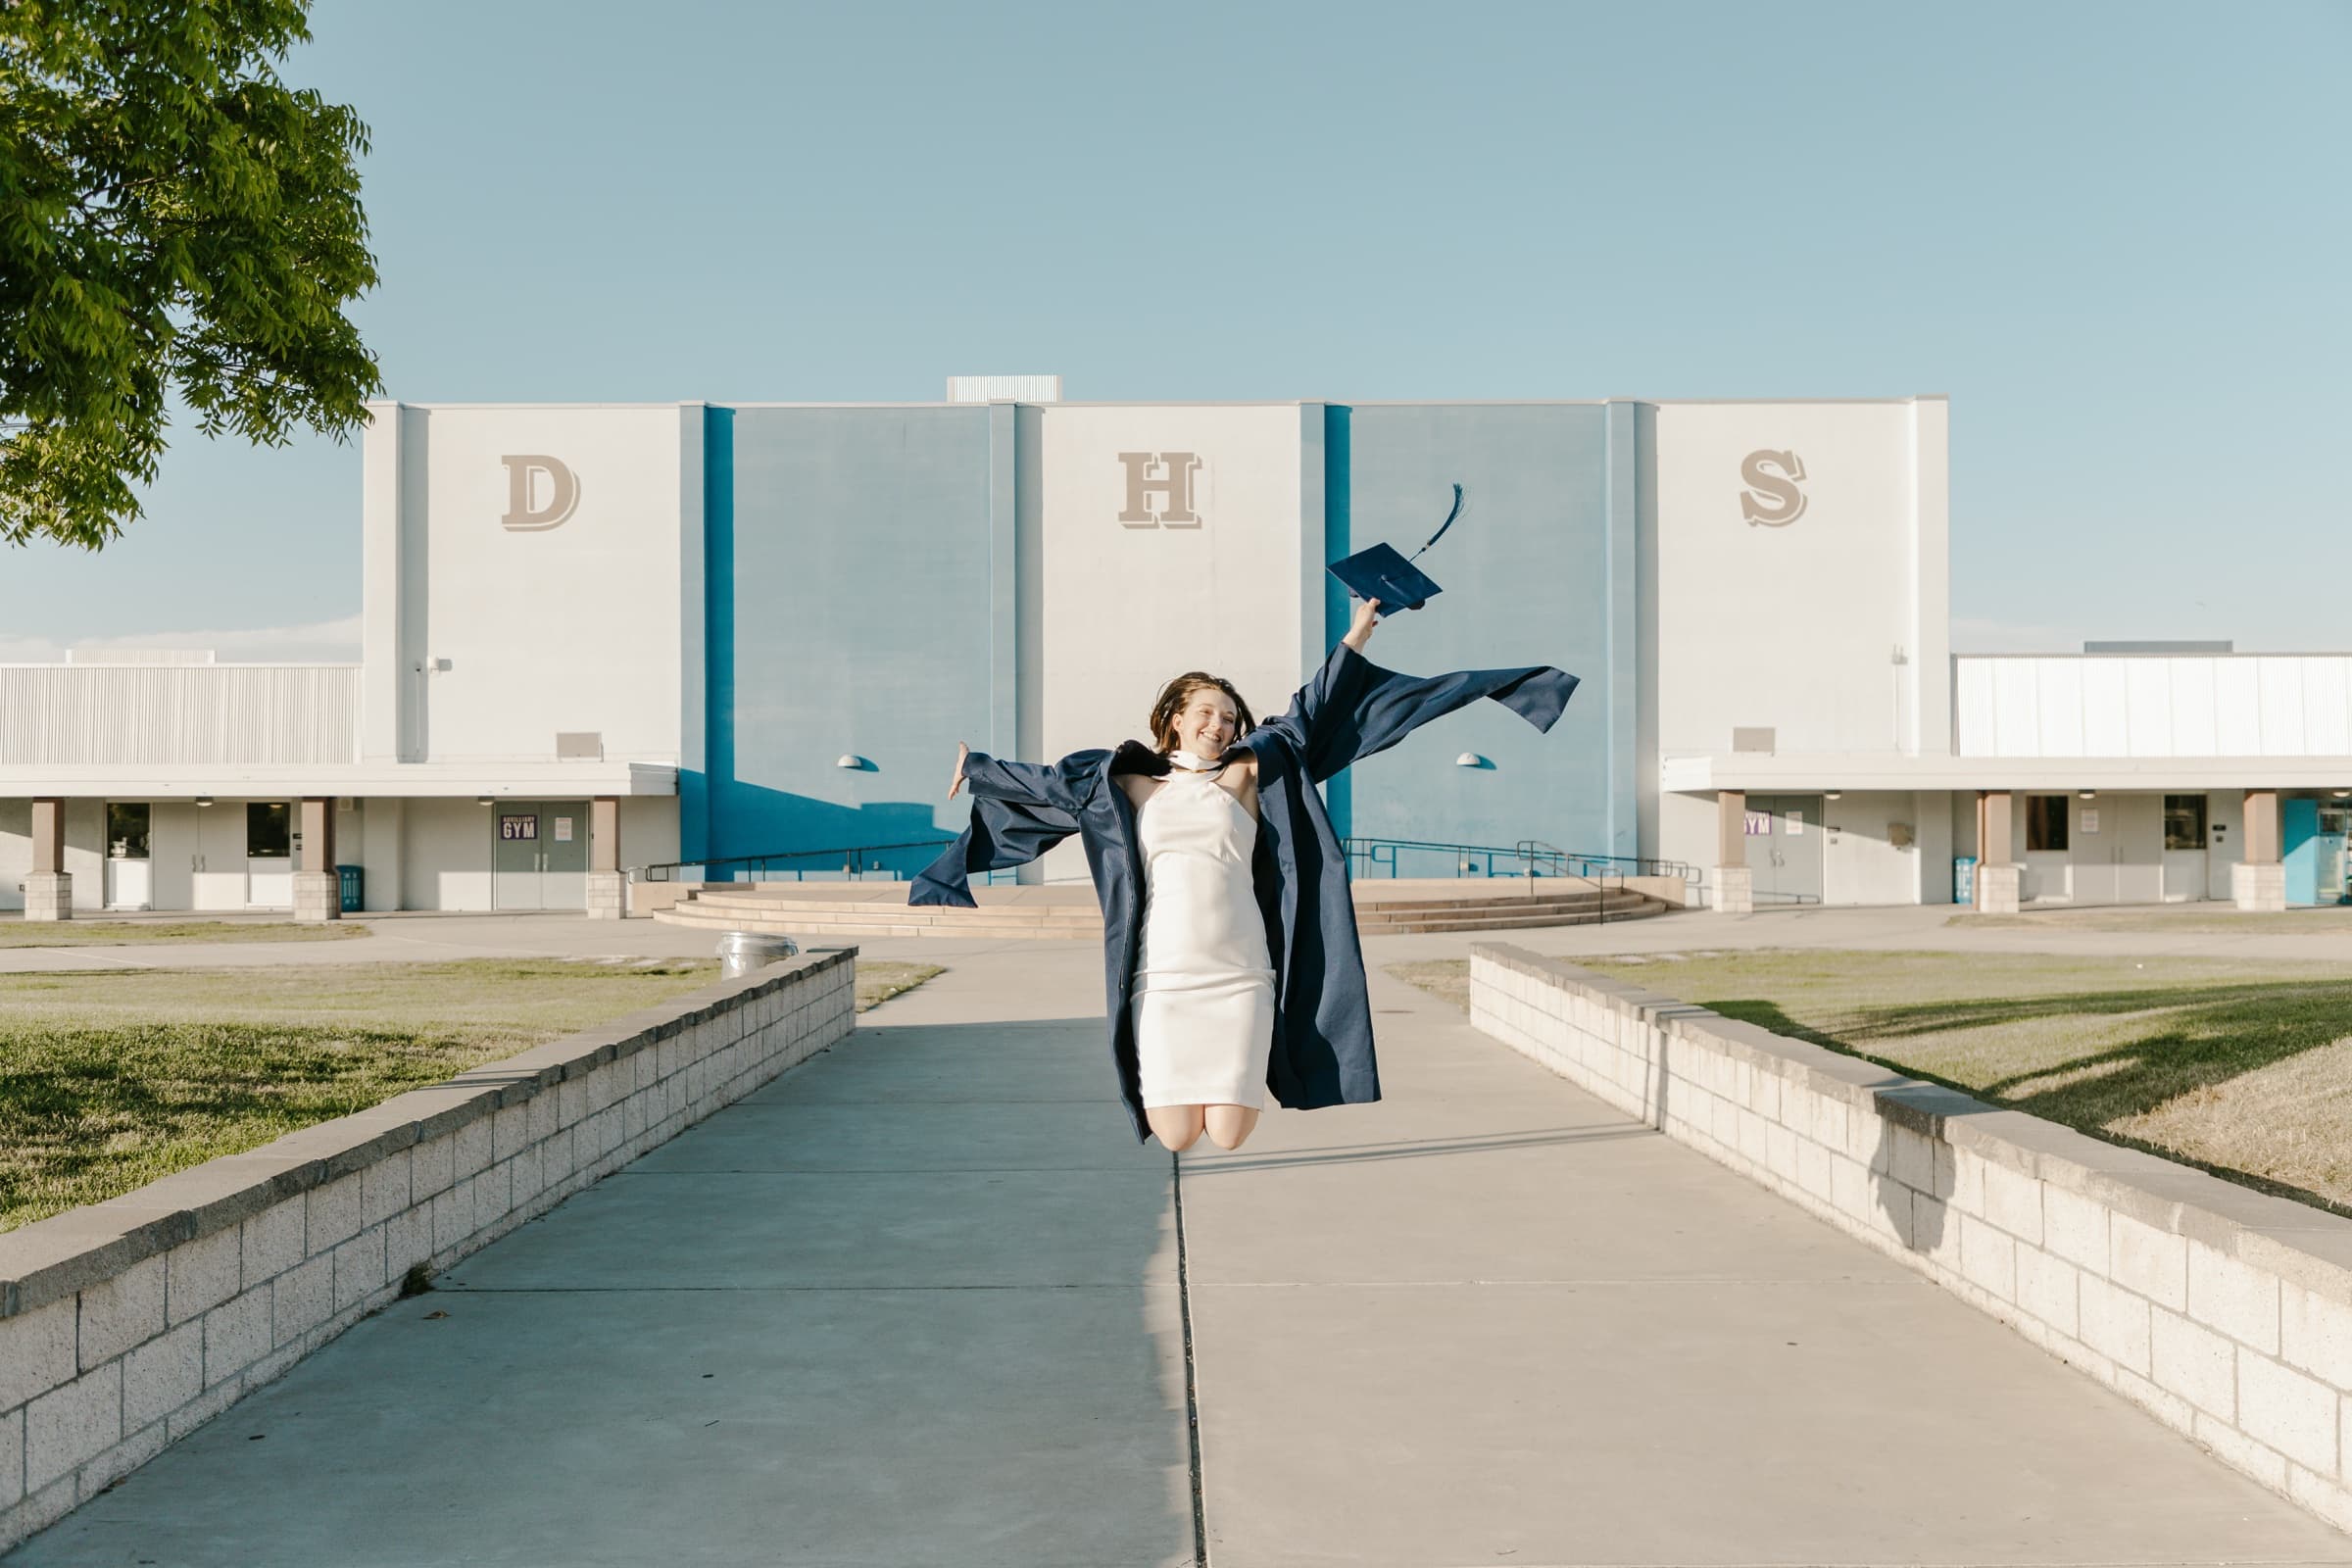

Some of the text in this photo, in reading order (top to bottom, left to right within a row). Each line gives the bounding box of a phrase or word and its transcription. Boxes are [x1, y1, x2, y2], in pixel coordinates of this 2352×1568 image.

[502, 449, 1807, 531] D H S
[503, 823, 535, 838] GYM
